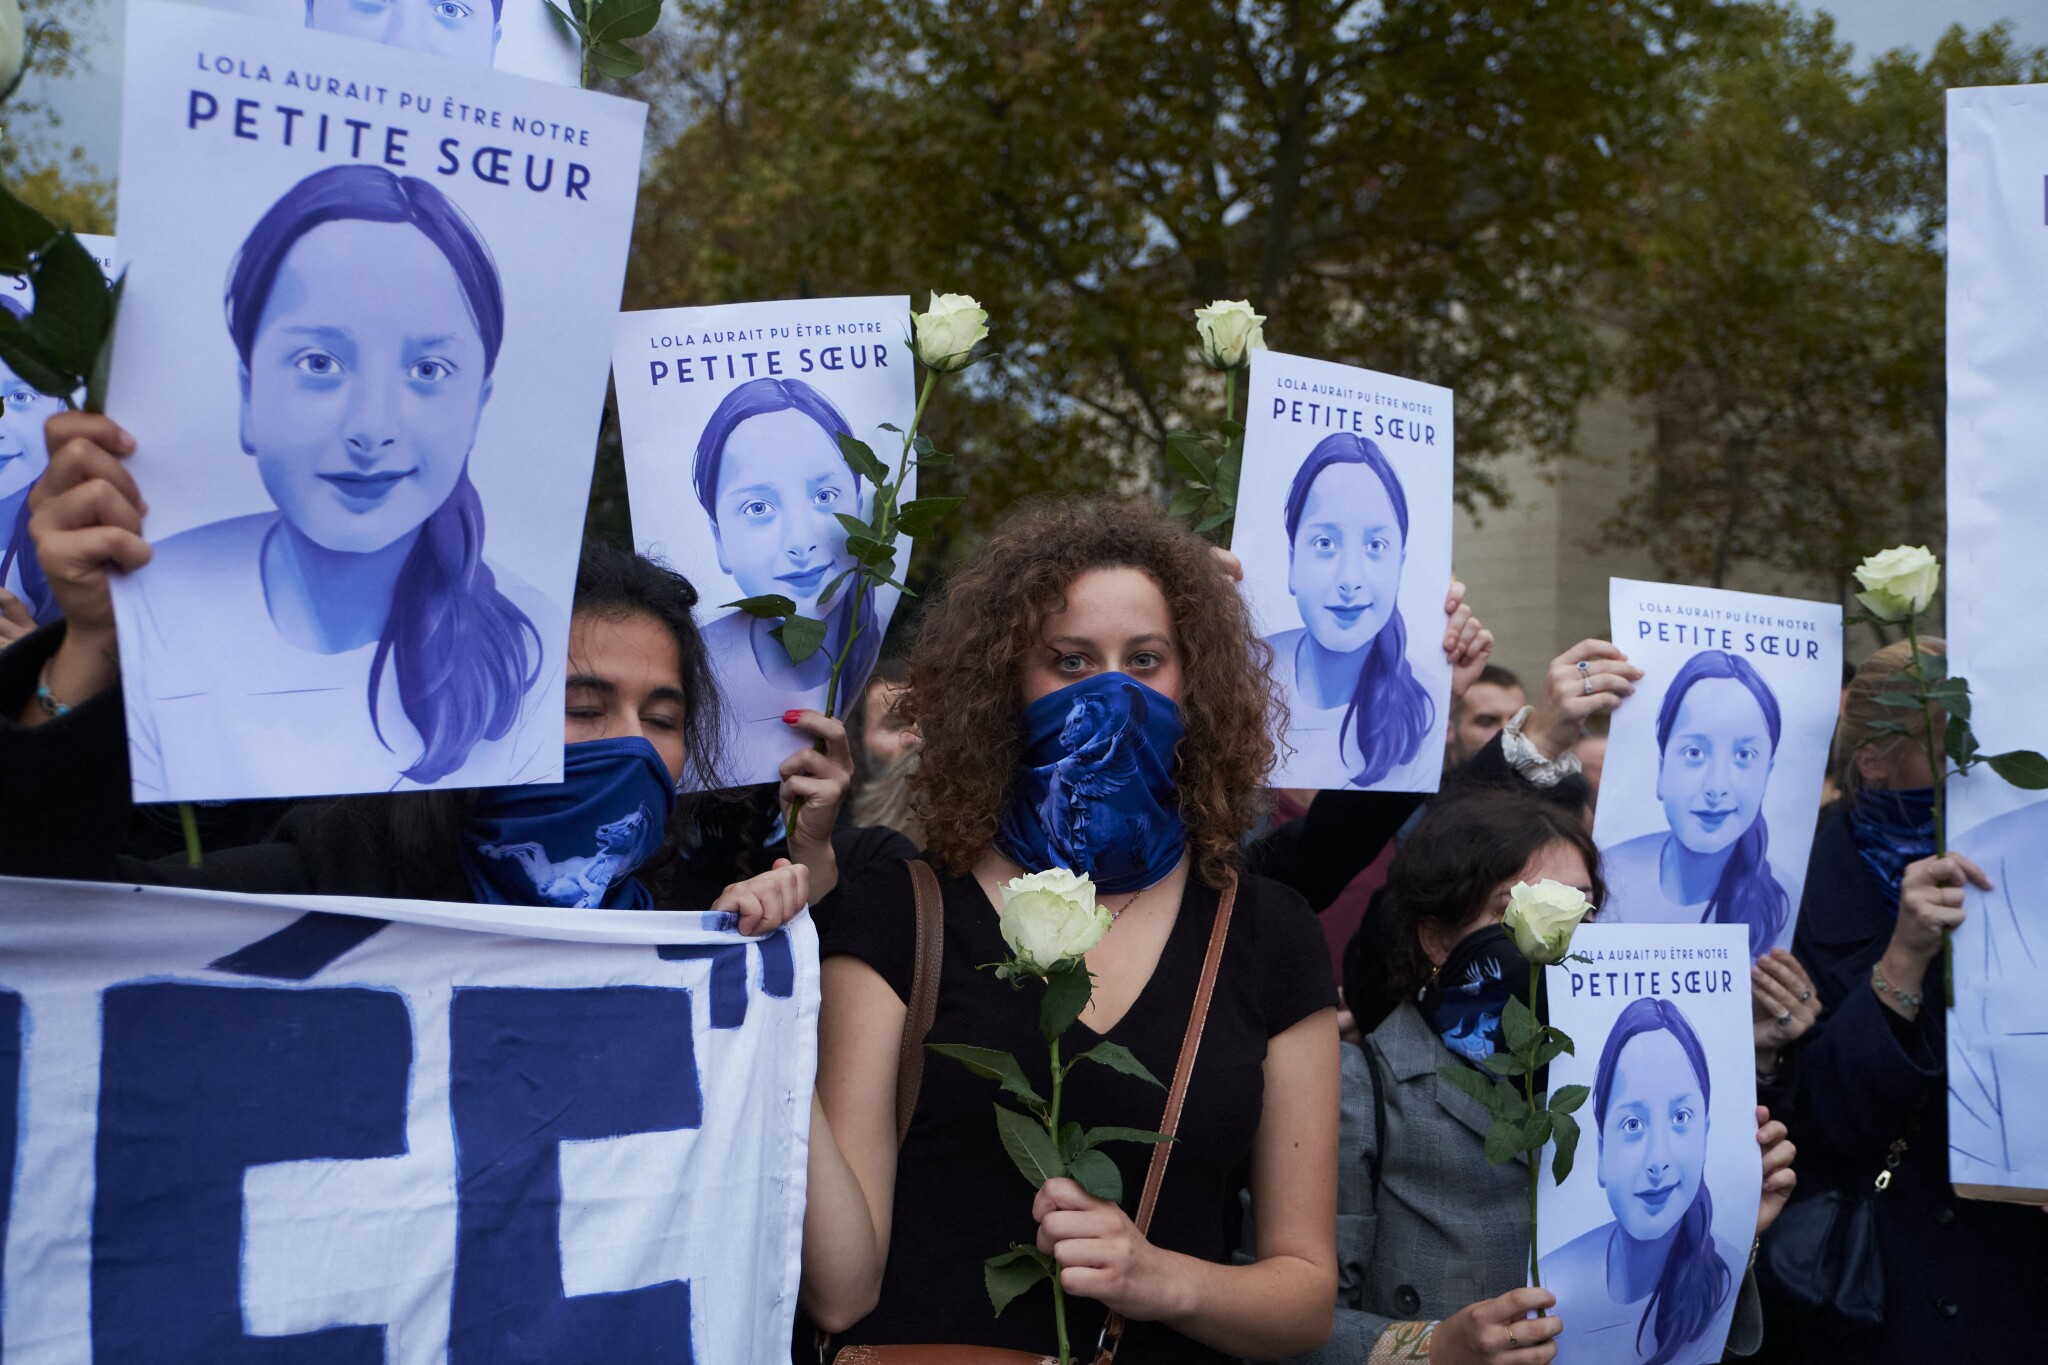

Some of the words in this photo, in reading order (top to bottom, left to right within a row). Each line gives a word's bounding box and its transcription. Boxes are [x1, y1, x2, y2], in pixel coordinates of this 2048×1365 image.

[198, 52, 272, 83] LOLA
[284, 70, 389, 106] AURAIT
[399, 92, 432, 114] PU
[443, 96, 502, 129] ÊTRE
[512, 115, 590, 147] NOTRE
[187, 89, 410, 167] PETITE
[436, 137, 592, 201] SŒUR
[650, 335, 696, 349] LOLA
[702, 328, 764, 345] AURAIT
[770, 327, 790, 340] PU
[797, 323, 832, 337] ÊTRE
[837, 322, 882, 335] NOTRE
[650, 351, 784, 386] PETITE
[799, 344, 889, 373] SŒUR
[1277, 377, 1308, 392] LOLA
[1311, 384, 1354, 399] AURAIT
[1358, 391, 1371, 403] PU
[1375, 391, 1399, 409] ÊTRE
[1402, 401, 1433, 416] NOTRE
[1272, 397, 1363, 433] PETITE
[1375, 414, 1436, 447] SŒUR
[1639, 602, 1672, 614] LOLA
[1676, 606, 1721, 619] AURAIT
[1726, 612, 1741, 623] PU
[1745, 613, 1773, 627] ÊTRE
[1777, 619, 1816, 632] NOTRE
[1638, 620, 1733, 650] PETITE
[1745, 633, 1820, 660] SŒUR
[1609, 949, 1651, 961] AURAIT
[1654, 949, 1667, 960] PU
[1670, 947, 1694, 960] ÊTRE
[1697, 948, 1729, 960] NOTRE
[1571, 972, 1661, 997] PETITE
[1671, 970, 1733, 994] SŒUR
